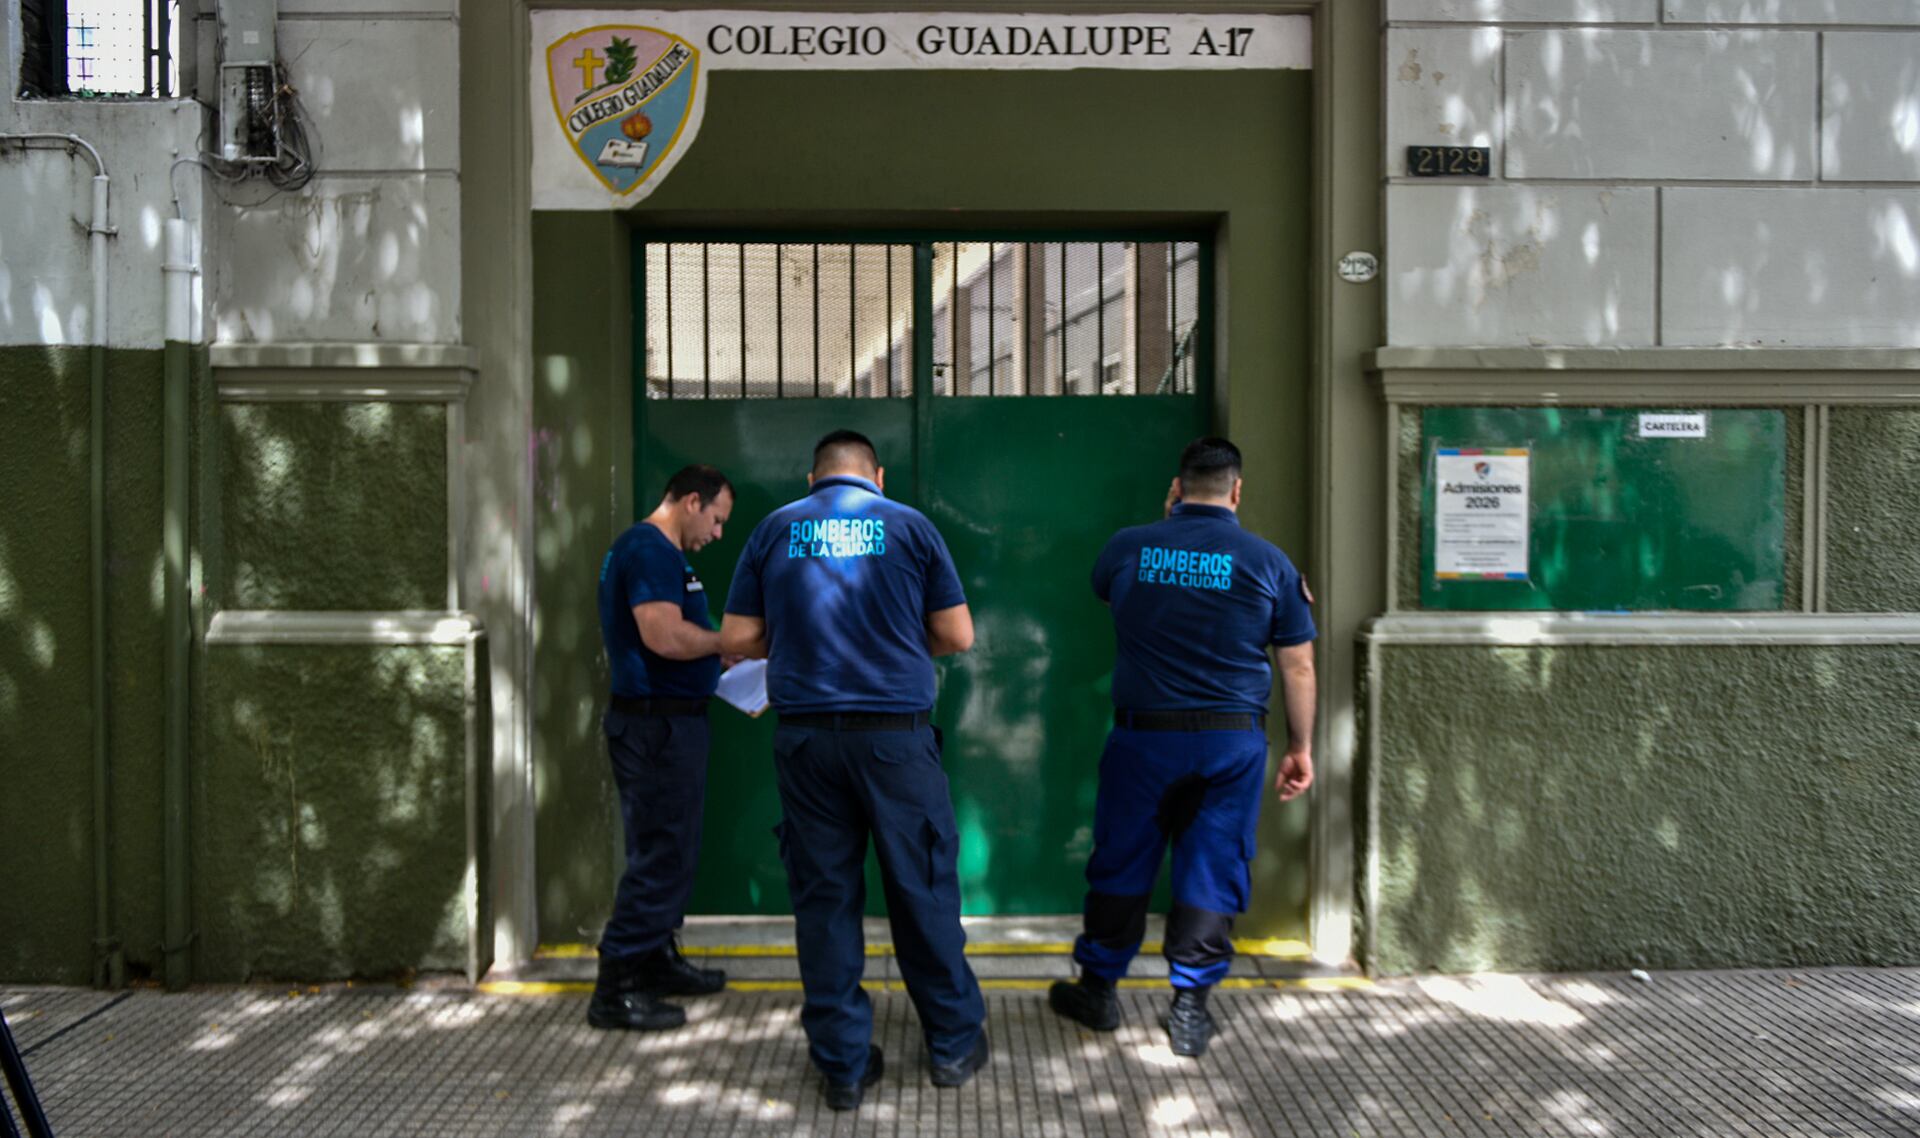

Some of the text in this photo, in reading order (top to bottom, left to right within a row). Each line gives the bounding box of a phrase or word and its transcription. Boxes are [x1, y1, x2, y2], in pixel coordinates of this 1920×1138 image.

[707, 25, 1255, 57] COLEGIO GUADALUPE A-17
[569, 43, 691, 133] COLEGIO GUADALUPE
[1417, 147, 1483, 173] 2129
[1443, 482, 1521, 494] Admisiones
[1465, 497, 1500, 509] 2026
[790, 519, 884, 543] BOMBEROS
[788, 542, 886, 558] DE LA CIUDAD
[1141, 547, 1232, 576] BOMBEROS
[1138, 569, 1231, 590] DE LA CIUDAD
